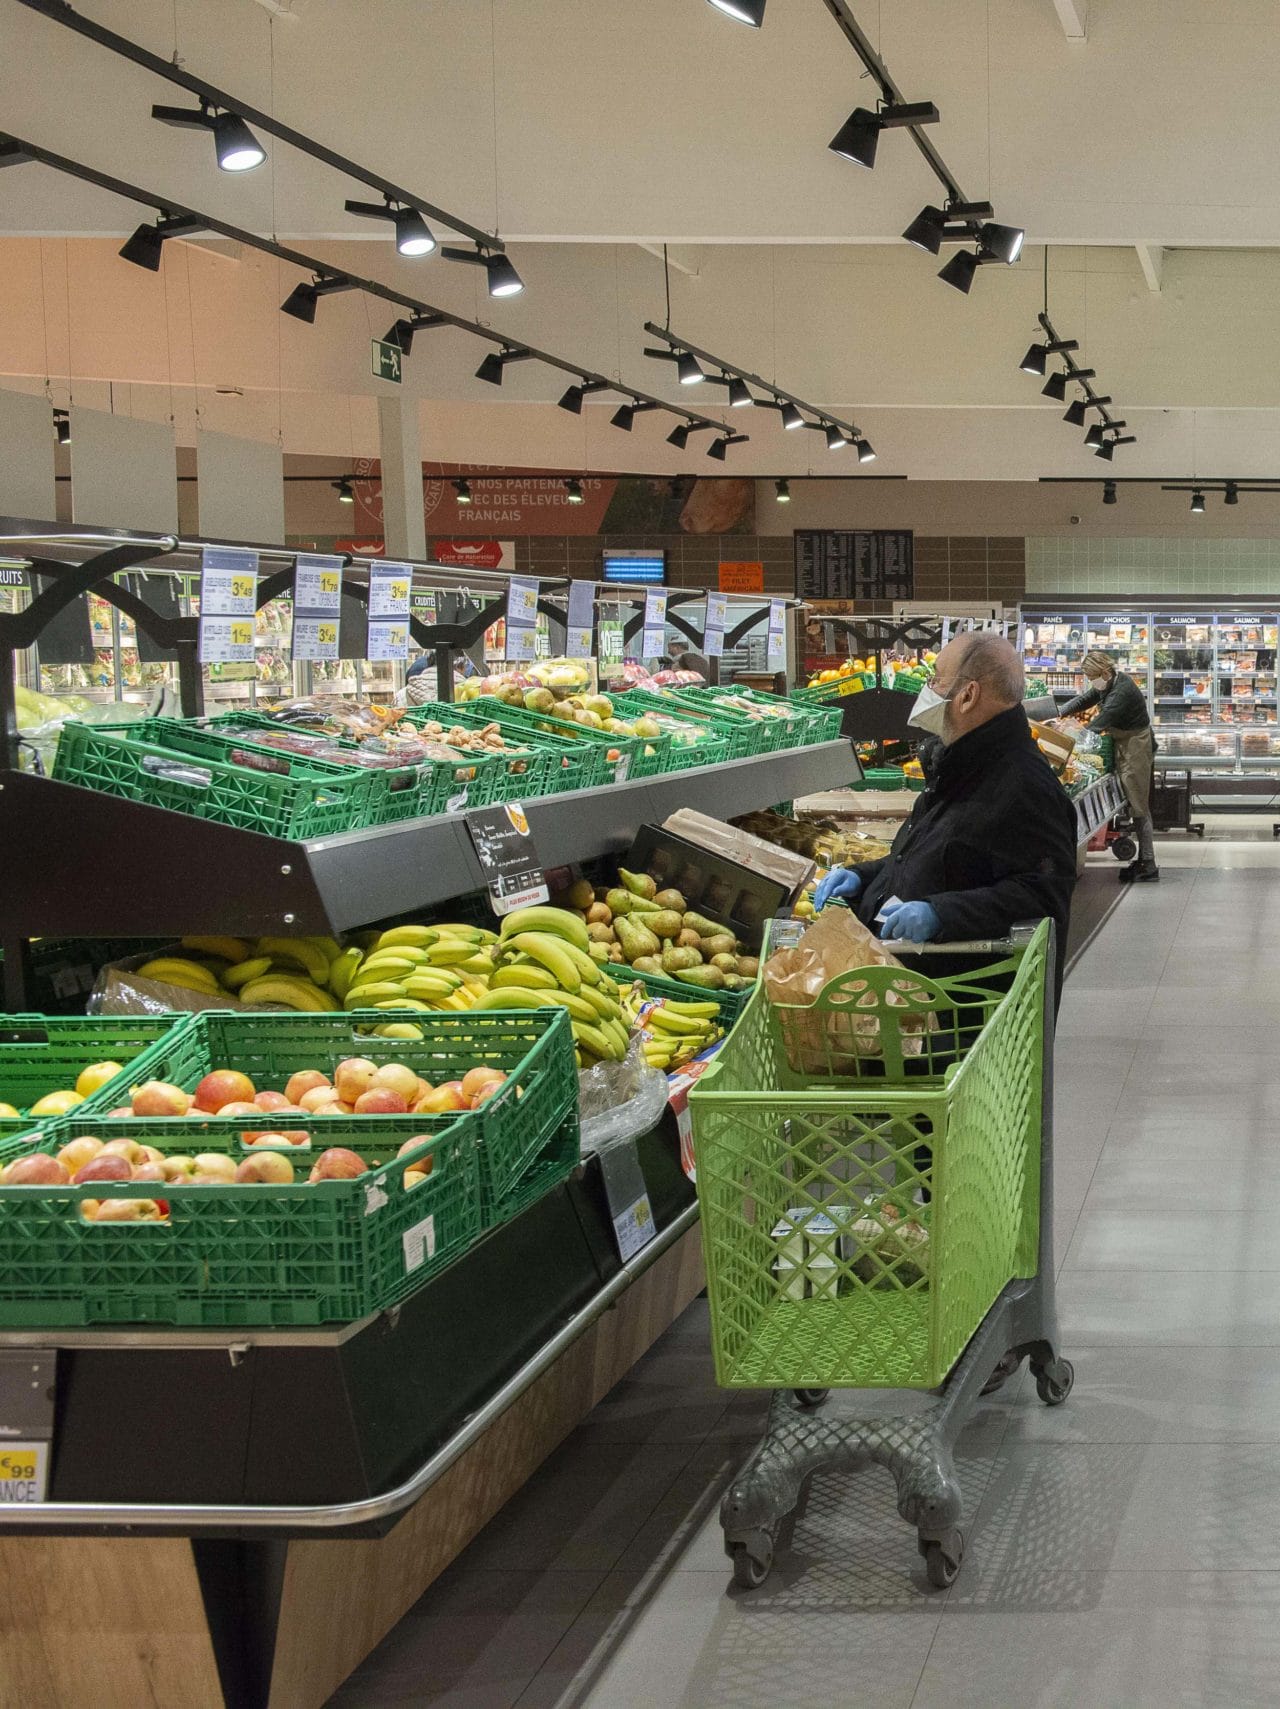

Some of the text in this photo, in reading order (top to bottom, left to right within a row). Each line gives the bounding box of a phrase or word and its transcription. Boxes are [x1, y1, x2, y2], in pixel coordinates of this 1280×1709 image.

[477, 479, 503, 490] NOS
[506, 479, 602, 490] PARTENAATS
[458, 490, 586, 506] VEC DES ÉLEVEUS
[458, 510, 521, 524] FRANÇAIS
[0, 570, 23, 585] RUITS
[232, 581, 253, 597] 3€49
[321, 578, 338, 593] 1€79
[1103, 616, 1131, 624] ANCHOIS
[232, 628, 252, 644] 1€79
[0, 1481, 36, 1502] NCE
